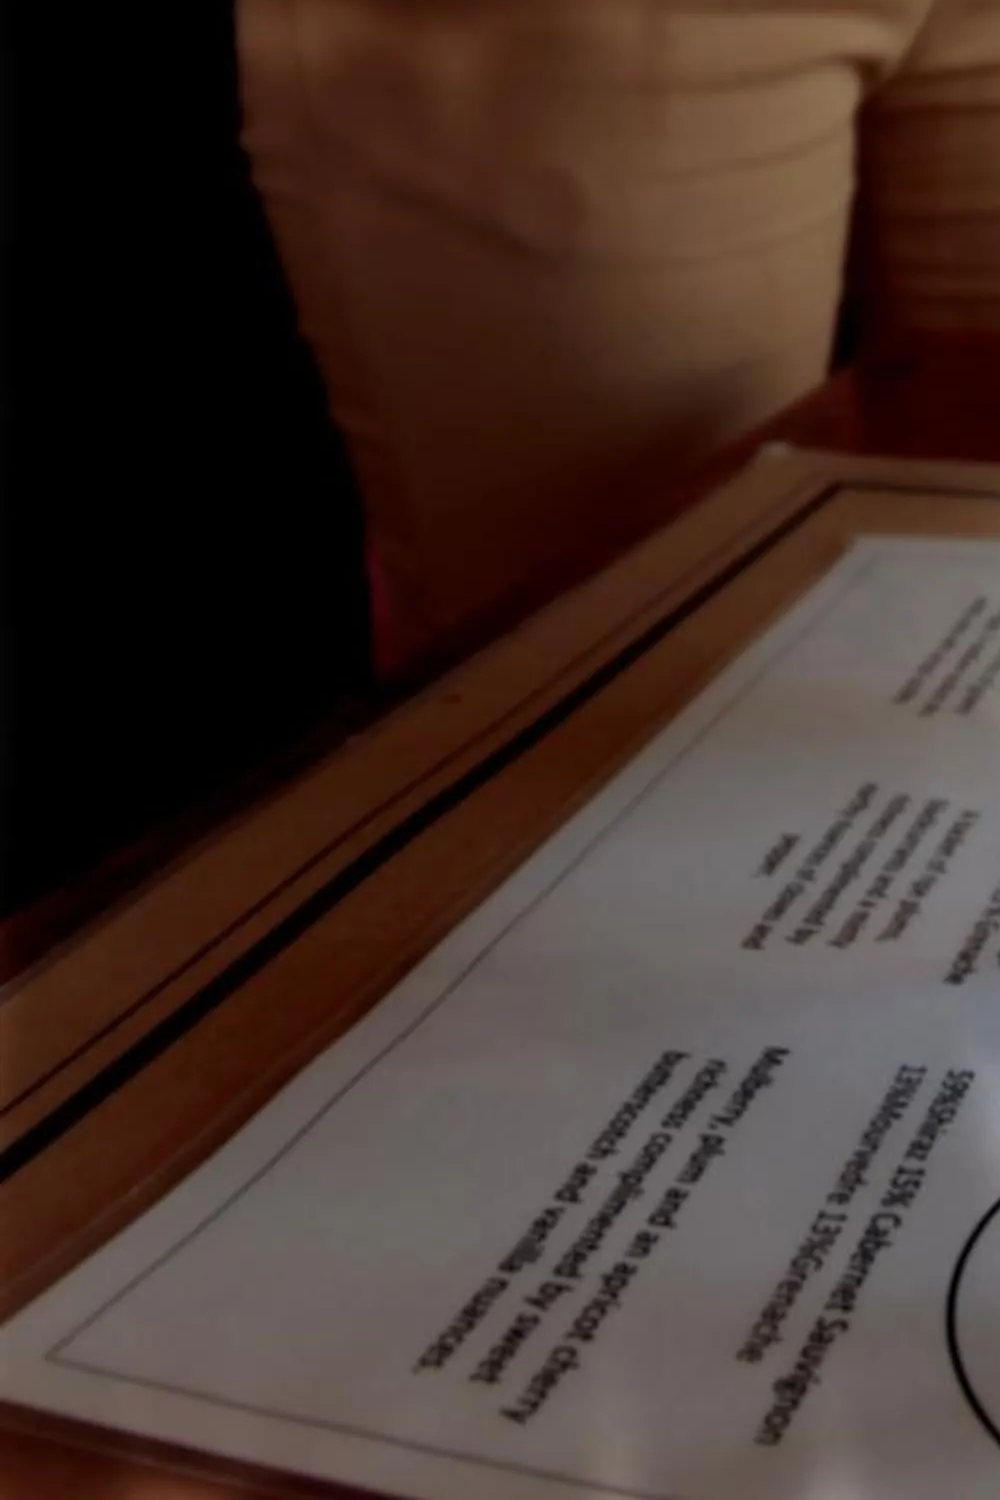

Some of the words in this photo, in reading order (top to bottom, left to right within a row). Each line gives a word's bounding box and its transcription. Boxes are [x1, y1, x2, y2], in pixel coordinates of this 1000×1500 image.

[586, 1049, 692, 1160] butterscotch
[661, 1057, 728, 1130] richness
[553, 1162, 598, 1204] and
[674, 1132, 725, 1184] plum
[498, 1205, 565, 1273] vanilla
[553, 1132, 673, 1279] complimented
[648, 1186, 690, 1230] and
[625, 1230, 660, 1259] an
[824, 1211, 902, 1313] Cabernet
[524, 1281, 574, 1312] by
[565, 1261, 638, 1343] apricot
[468, 1312, 541, 1385] sweet
[498, 1345, 580, 1425] cherry
[753, 1315, 851, 1447] Sauvignon
